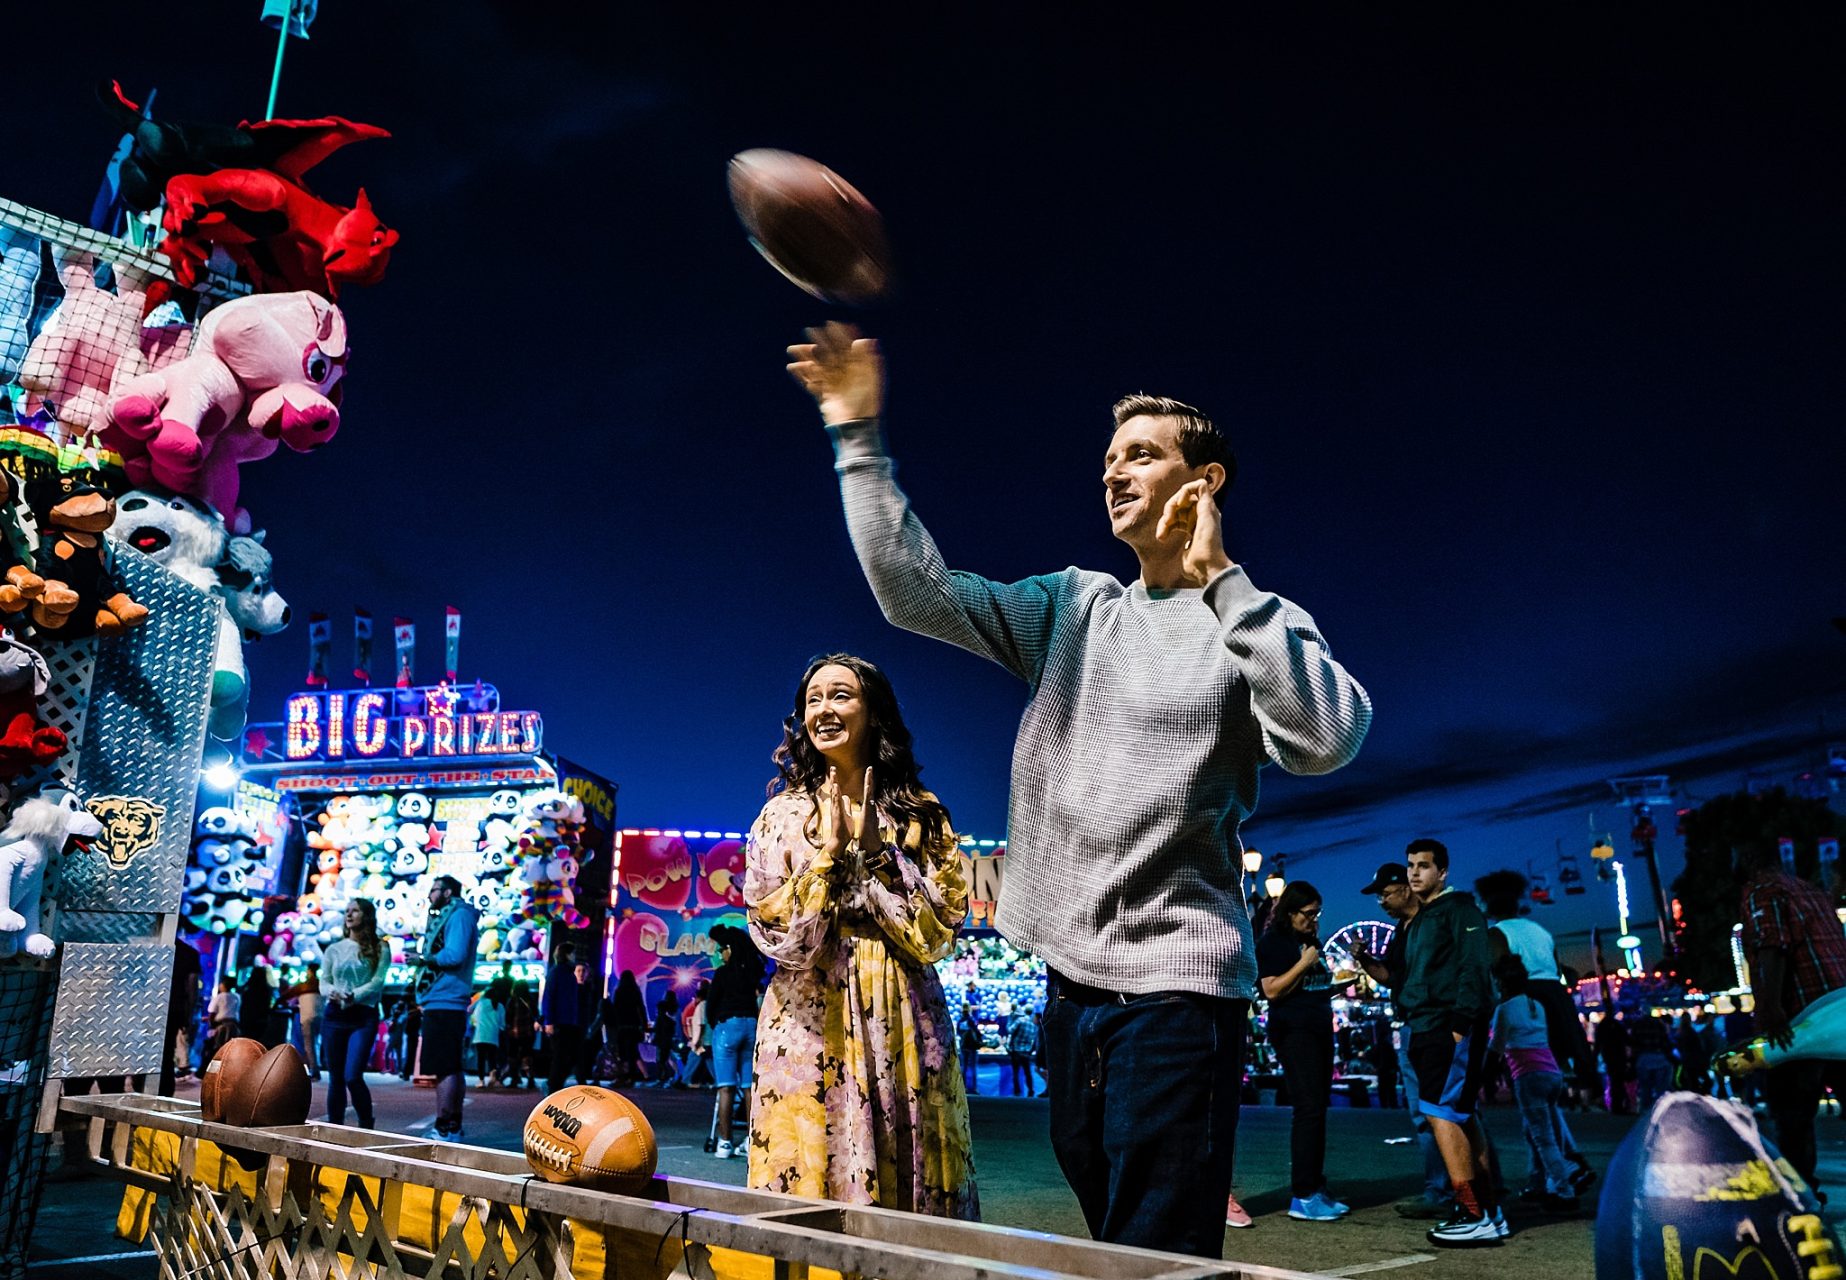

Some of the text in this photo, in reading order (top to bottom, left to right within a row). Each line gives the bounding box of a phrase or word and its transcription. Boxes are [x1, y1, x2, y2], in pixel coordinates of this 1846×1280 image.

[287, 693, 388, 759] BIG
[402, 711, 543, 757] PRIZES
[276, 775, 357, 790] SHOOT
[368, 773, 418, 786] OUT
[427, 770, 480, 784] THE
